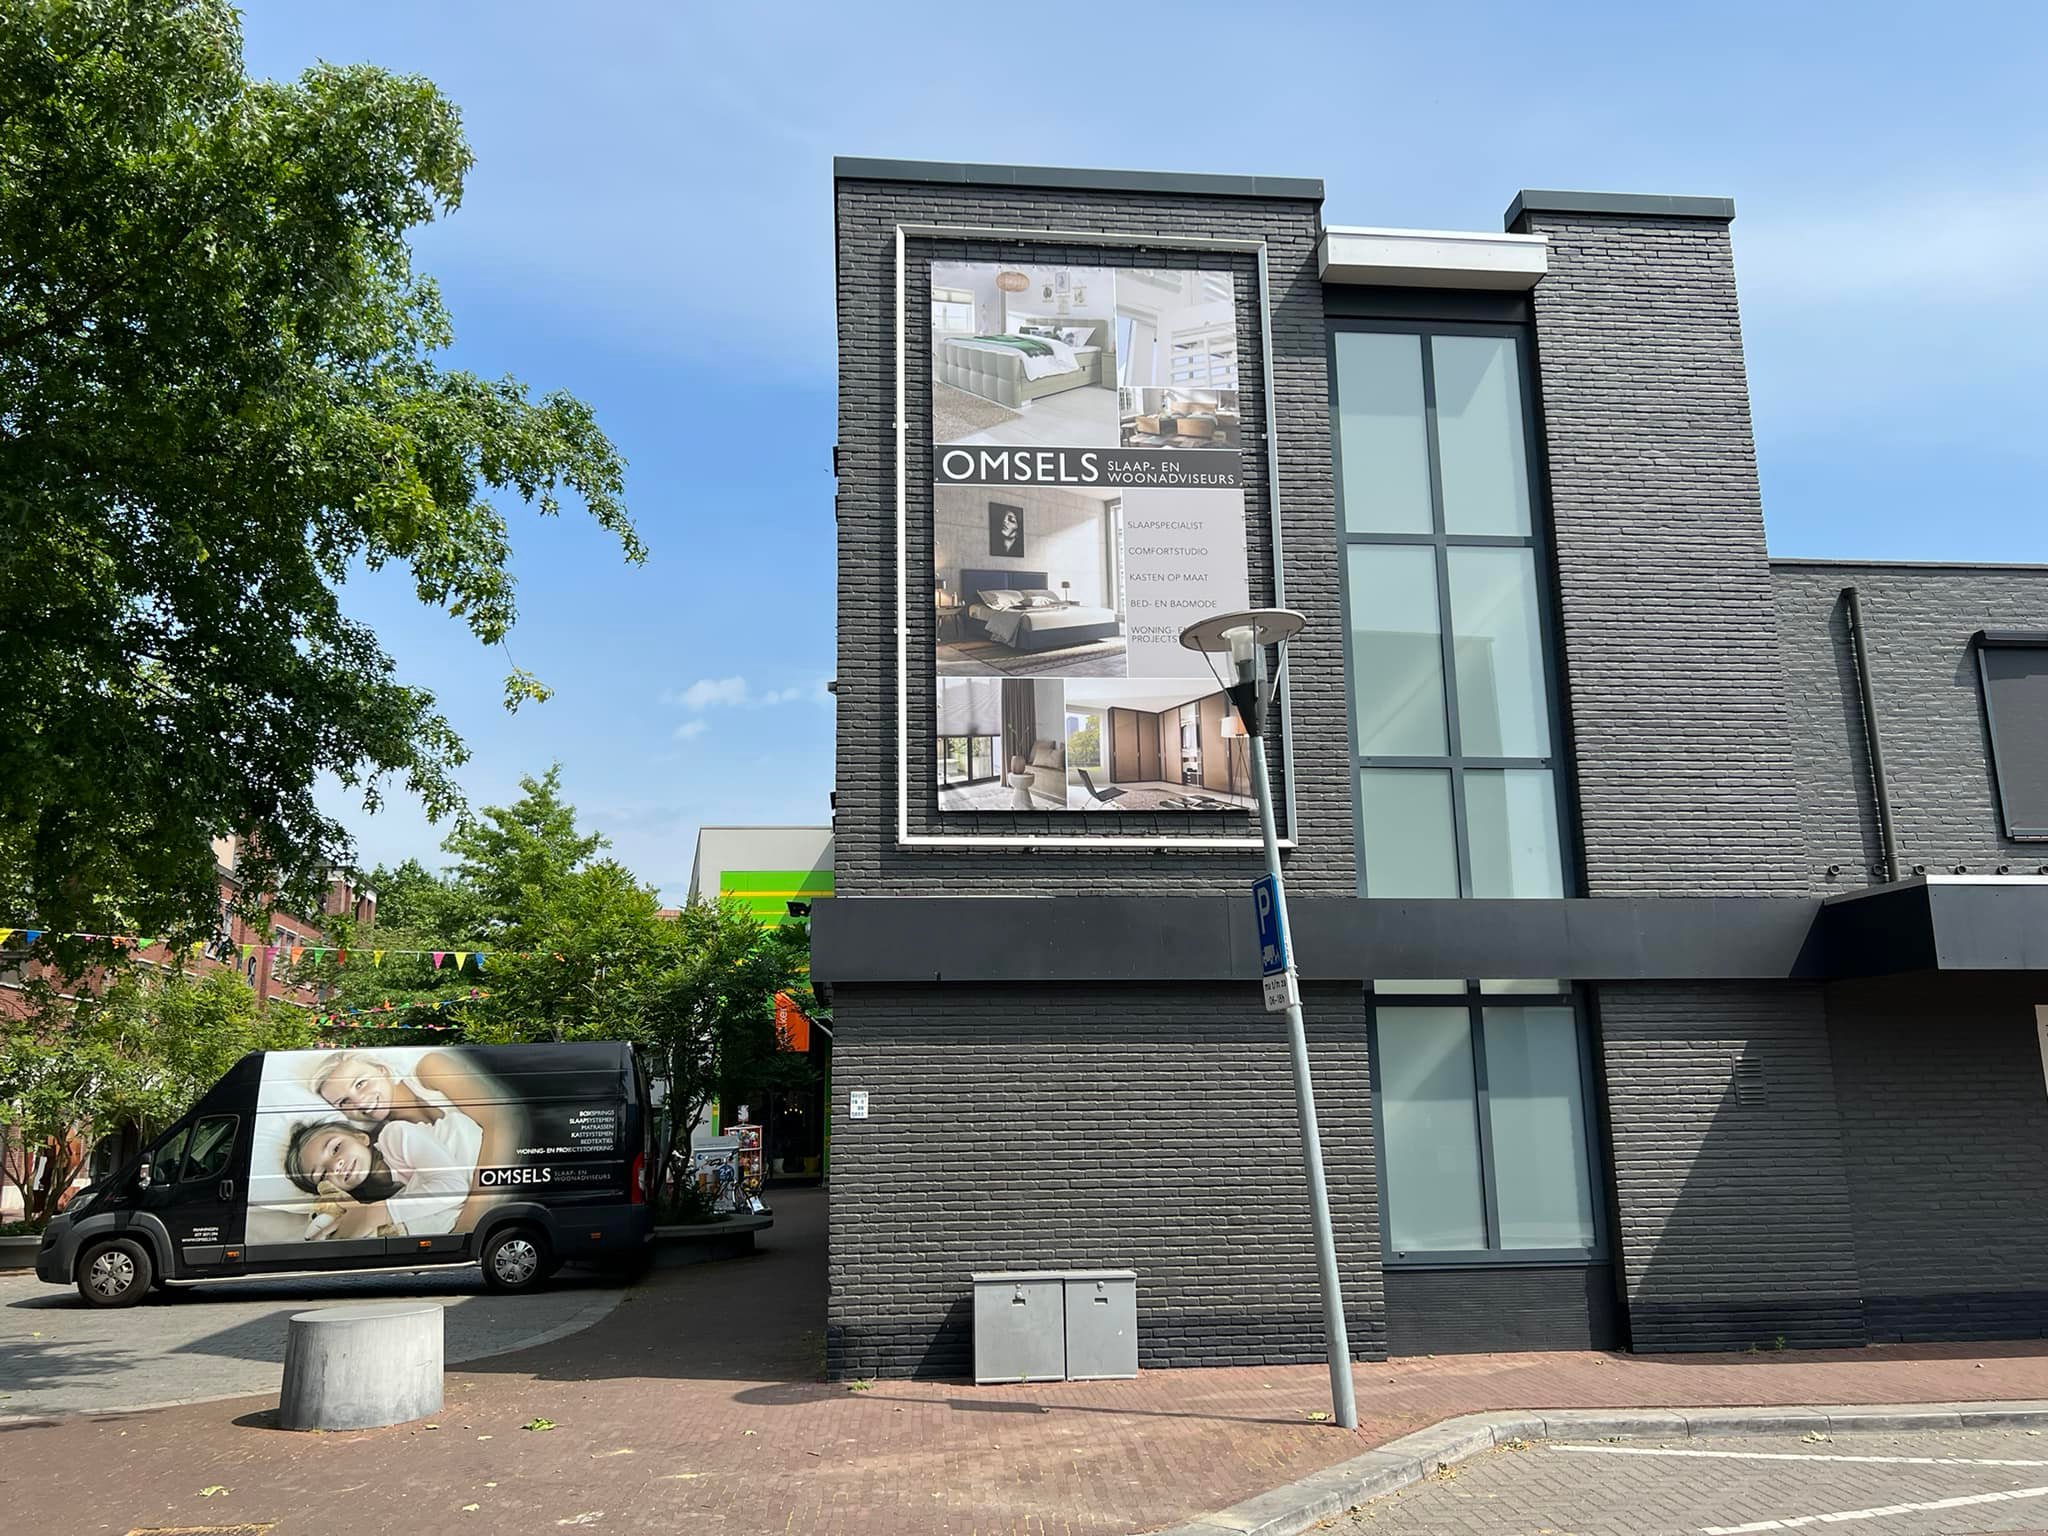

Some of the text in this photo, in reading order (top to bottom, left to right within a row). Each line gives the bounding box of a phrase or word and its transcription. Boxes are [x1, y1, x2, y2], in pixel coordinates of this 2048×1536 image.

[942, 450, 1099, 482] OMSELS
[1107, 460, 1180, 472] SLAAP- EN
[1107, 472, 1235, 485] WOONADVISEURS
[1127, 520, 1204, 530] SLAAPSPECIALIST
[1128, 546, 1209, 556] COMFORTSTUDIO
[1129, 573, 1208, 582] KASTEN OP MAAT
[1130, 599, 1217, 608] BED- EN BADMODE
[1257, 886, 1271, 935] P
[481, 1168, 551, 1185] OMSELS
